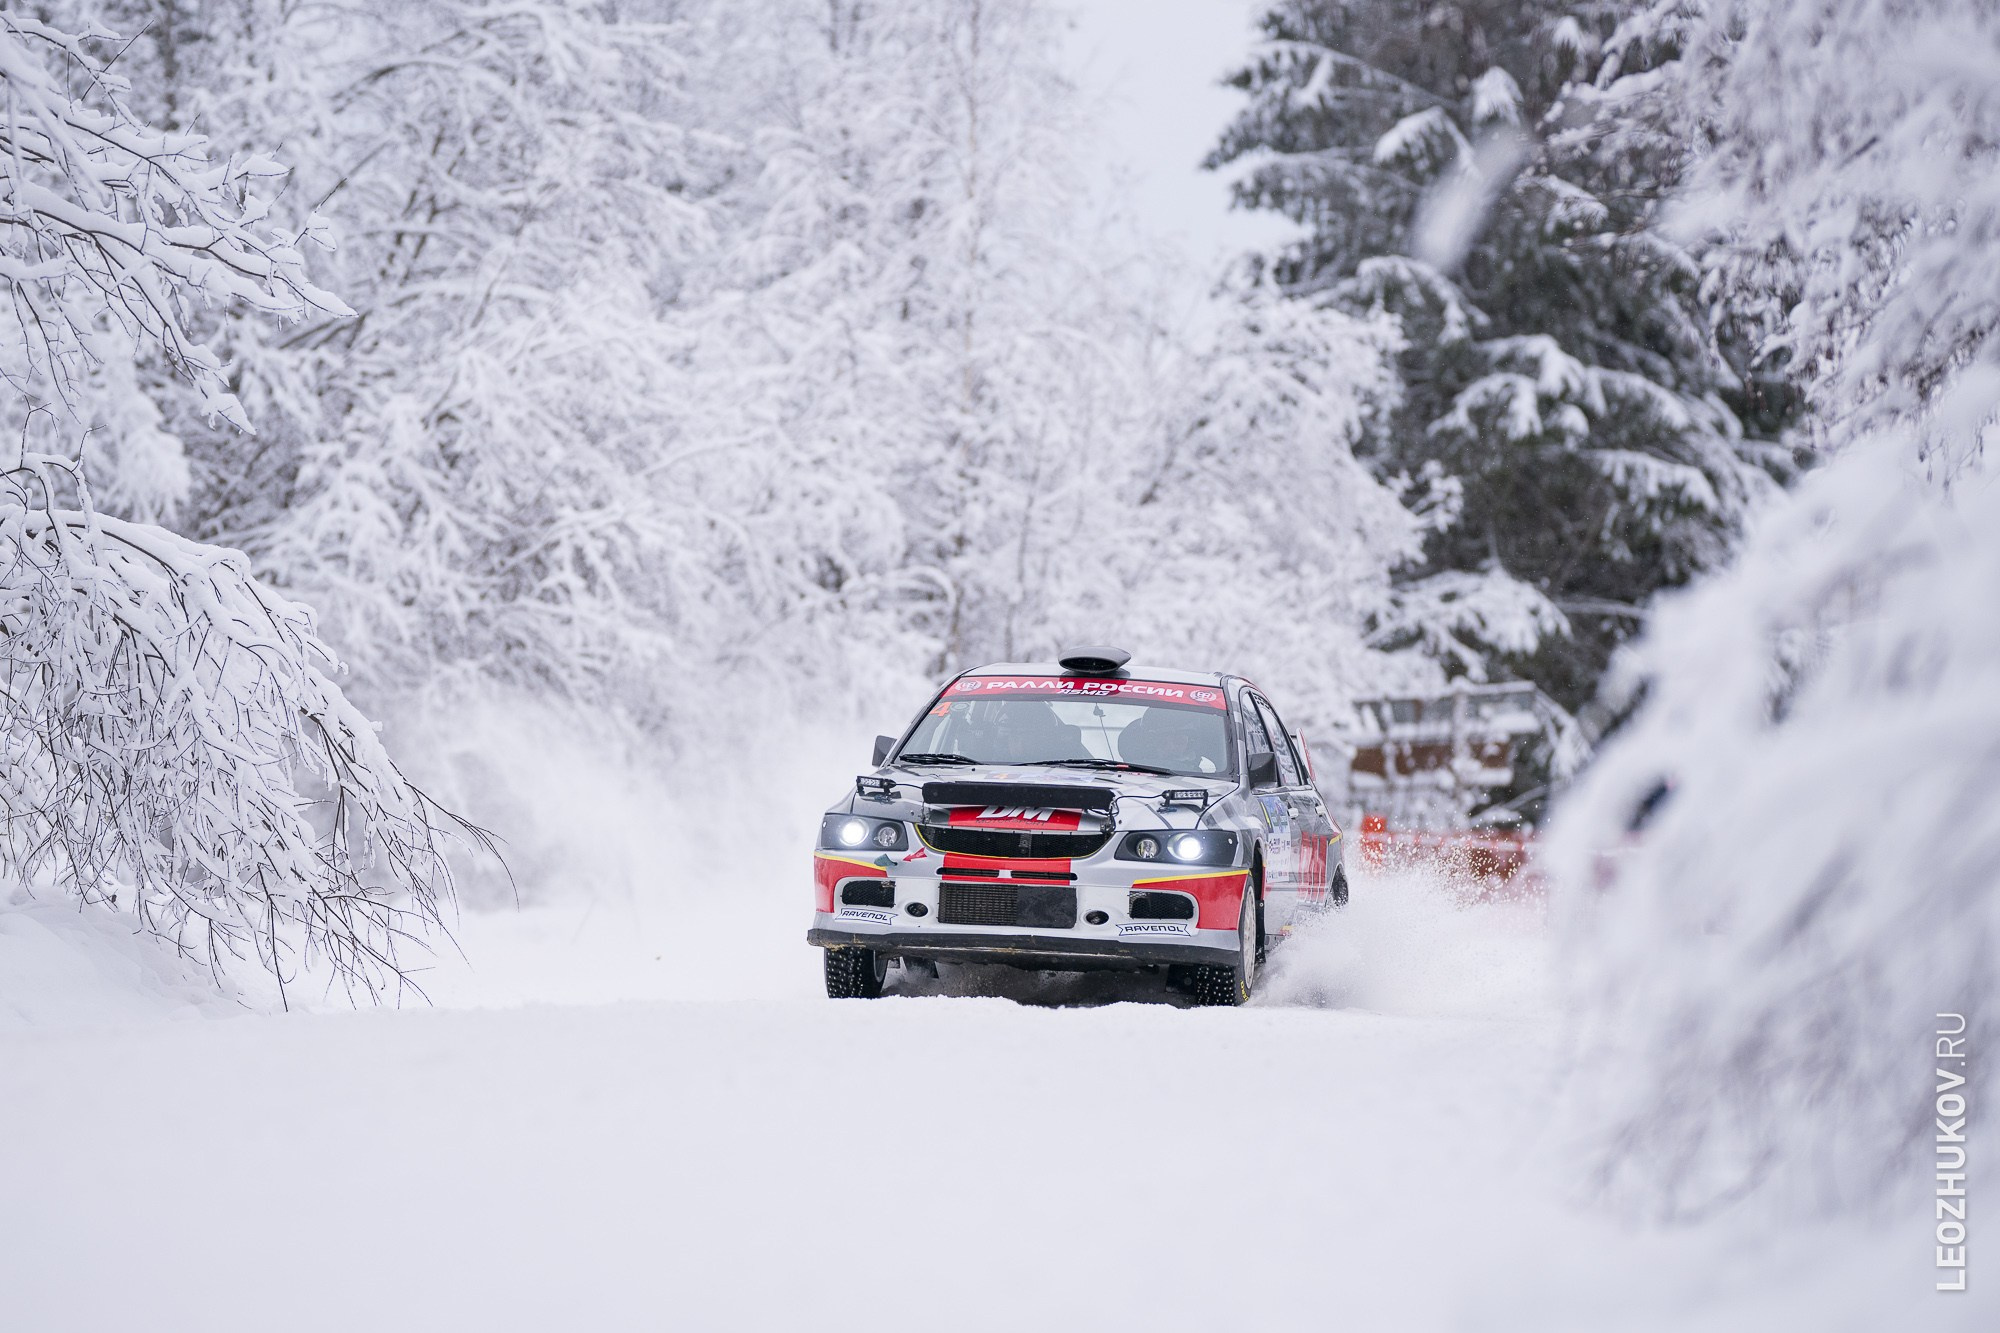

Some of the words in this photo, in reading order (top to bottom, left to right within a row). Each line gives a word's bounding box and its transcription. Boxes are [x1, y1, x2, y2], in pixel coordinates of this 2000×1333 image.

[986, 680, 1075, 690] РАЛЛИ
[1082, 682, 1184, 698] РОССИИ
[929, 701, 952, 717] 4
[842, 910, 888, 921] RAVENOL
[1124, 925, 1184, 933] RAVENOL
